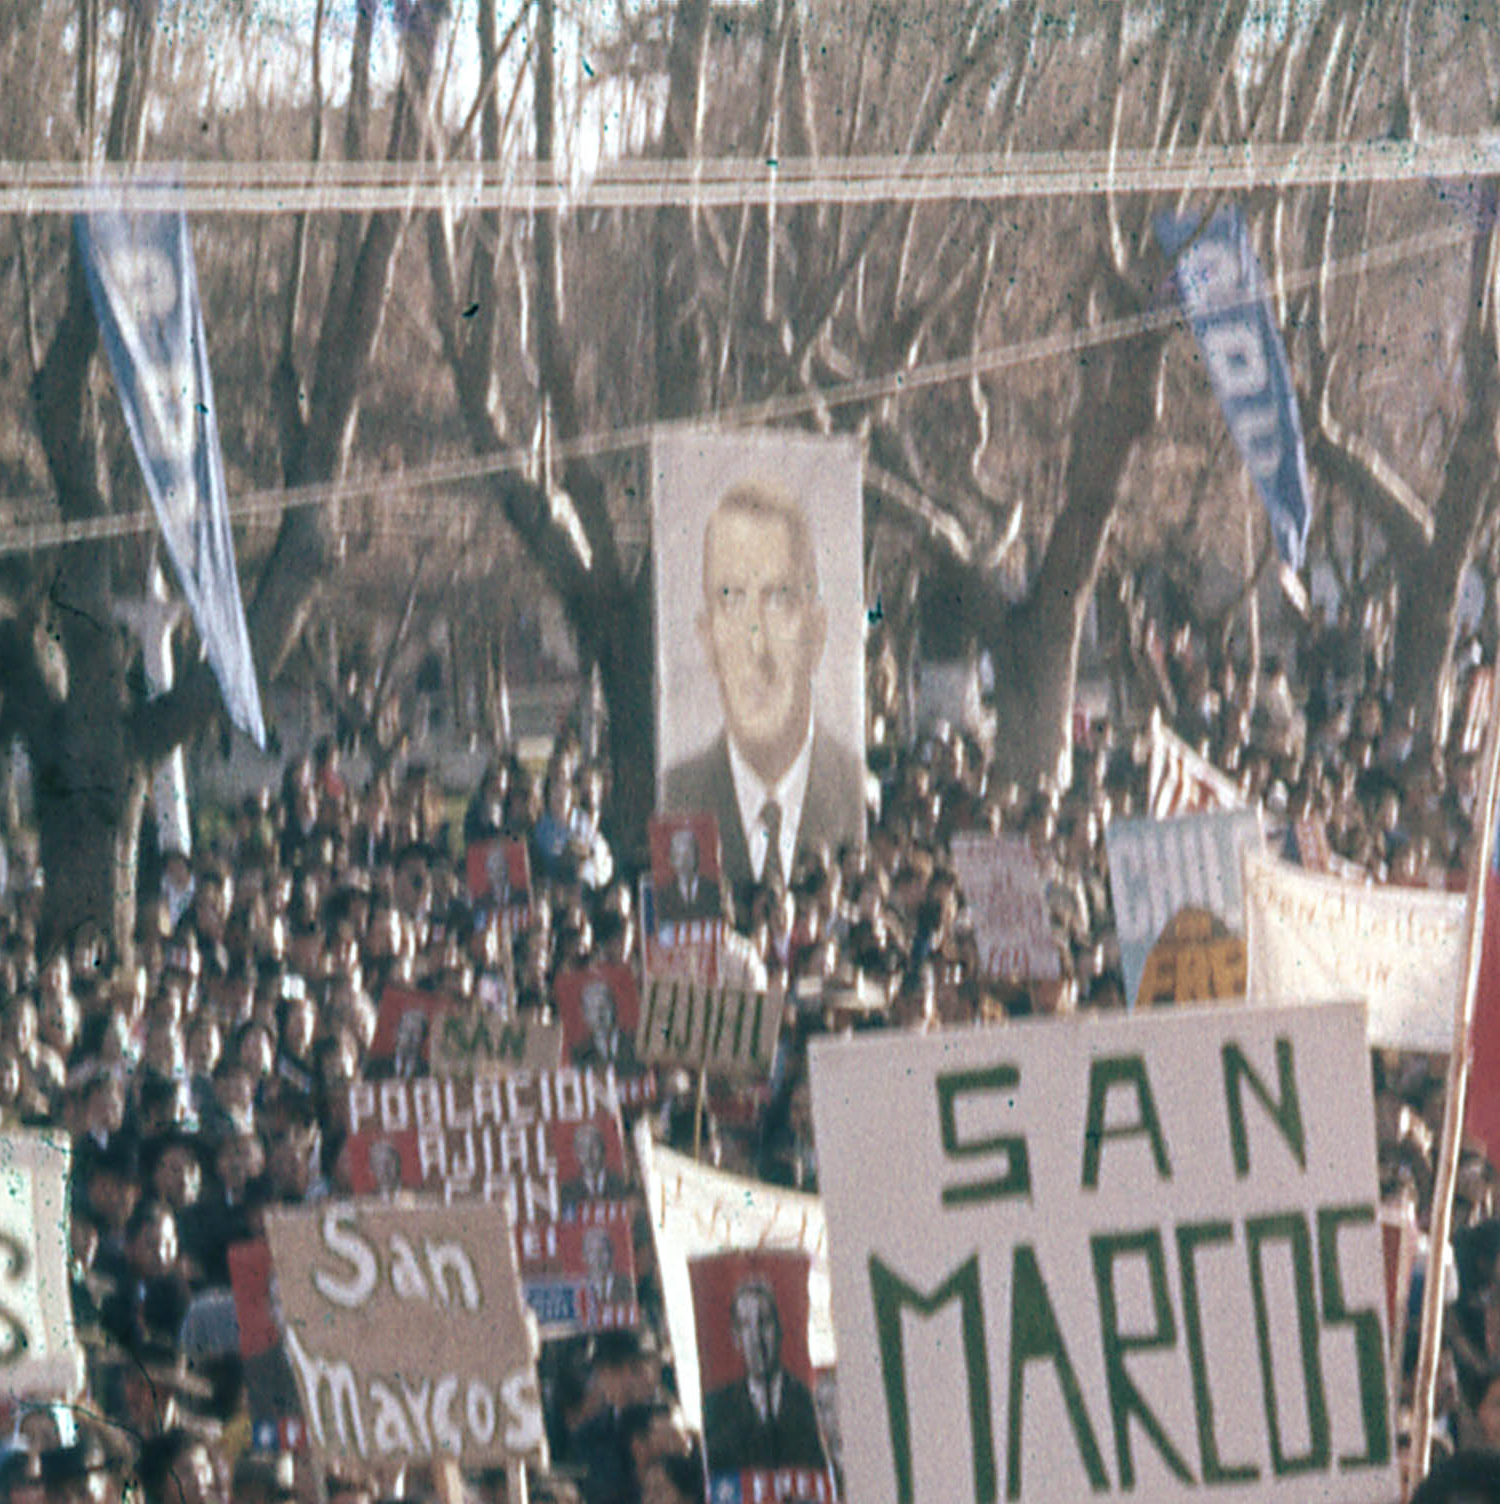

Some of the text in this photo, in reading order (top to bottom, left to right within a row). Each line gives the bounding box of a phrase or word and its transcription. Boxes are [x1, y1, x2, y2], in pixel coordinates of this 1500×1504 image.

[934, 1036, 1308, 1205] SAN
[312, 1208, 482, 1312] San
[286, 1326, 542, 1462] Marcos
